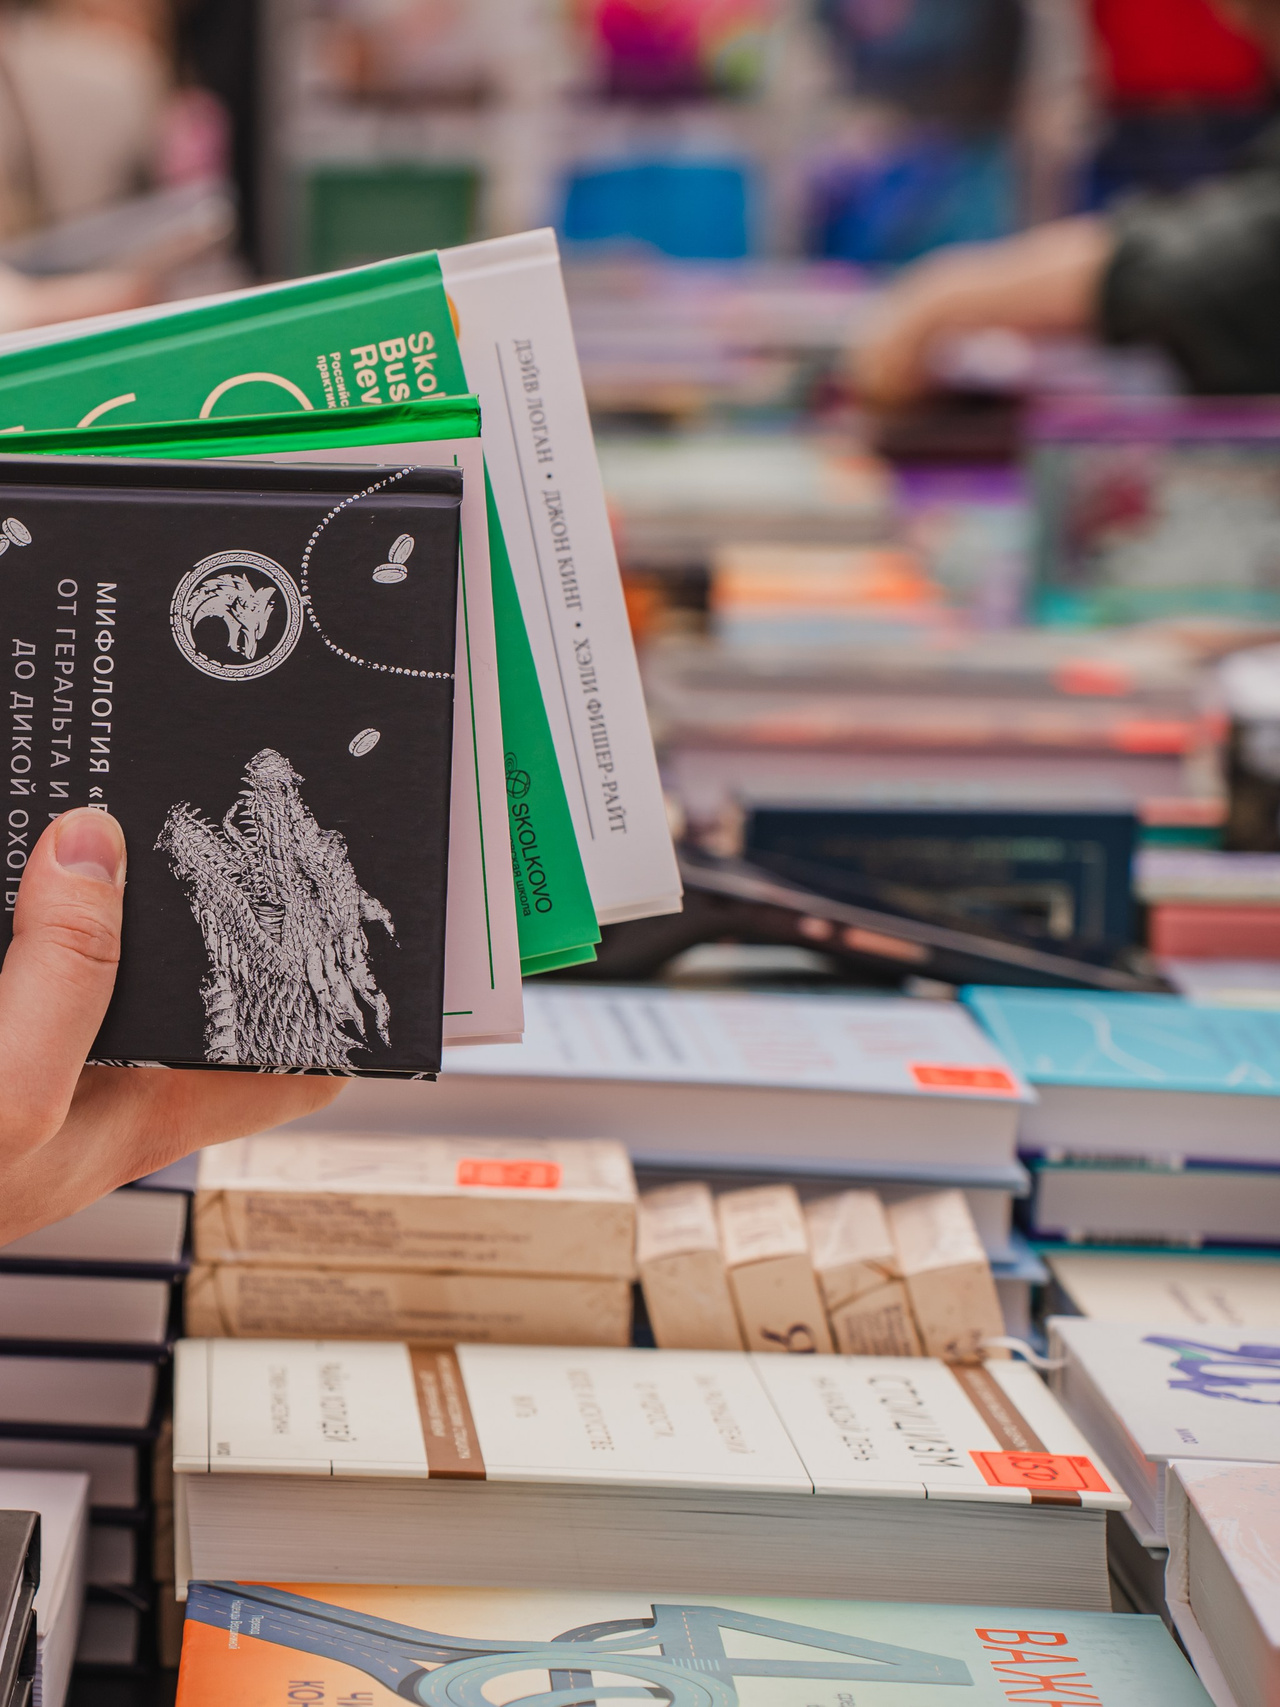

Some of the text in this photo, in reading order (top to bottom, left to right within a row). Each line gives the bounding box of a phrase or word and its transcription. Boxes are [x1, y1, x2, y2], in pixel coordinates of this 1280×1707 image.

[329, 351, 351, 407] Российс
[350, 344, 382, 404] Rev
[378, 337, 410, 402] Bus
[56, 578, 78, 616] ОТ
[513, 339, 627, 835] ДЭЙВ ЛОГАН ДЖОН КИНГ ХЭЛИ ФИШЕР-РАЙТ
[11, 638, 37, 680] ДО
[88, 581, 117, 774] МИФОЛОГИЯ
[50, 628, 76, 768] ГЕРАЛЬТА
[9, 690, 37, 797] ДИКОЙ
[48, 780, 70, 799] И
[510, 803, 552, 914] SKOLKOVO
[515, 880, 532, 917] школа
[866, 1374, 965, 1468] СТОИЦИЗМ
[249, 1614, 265, 1636] Перевод
